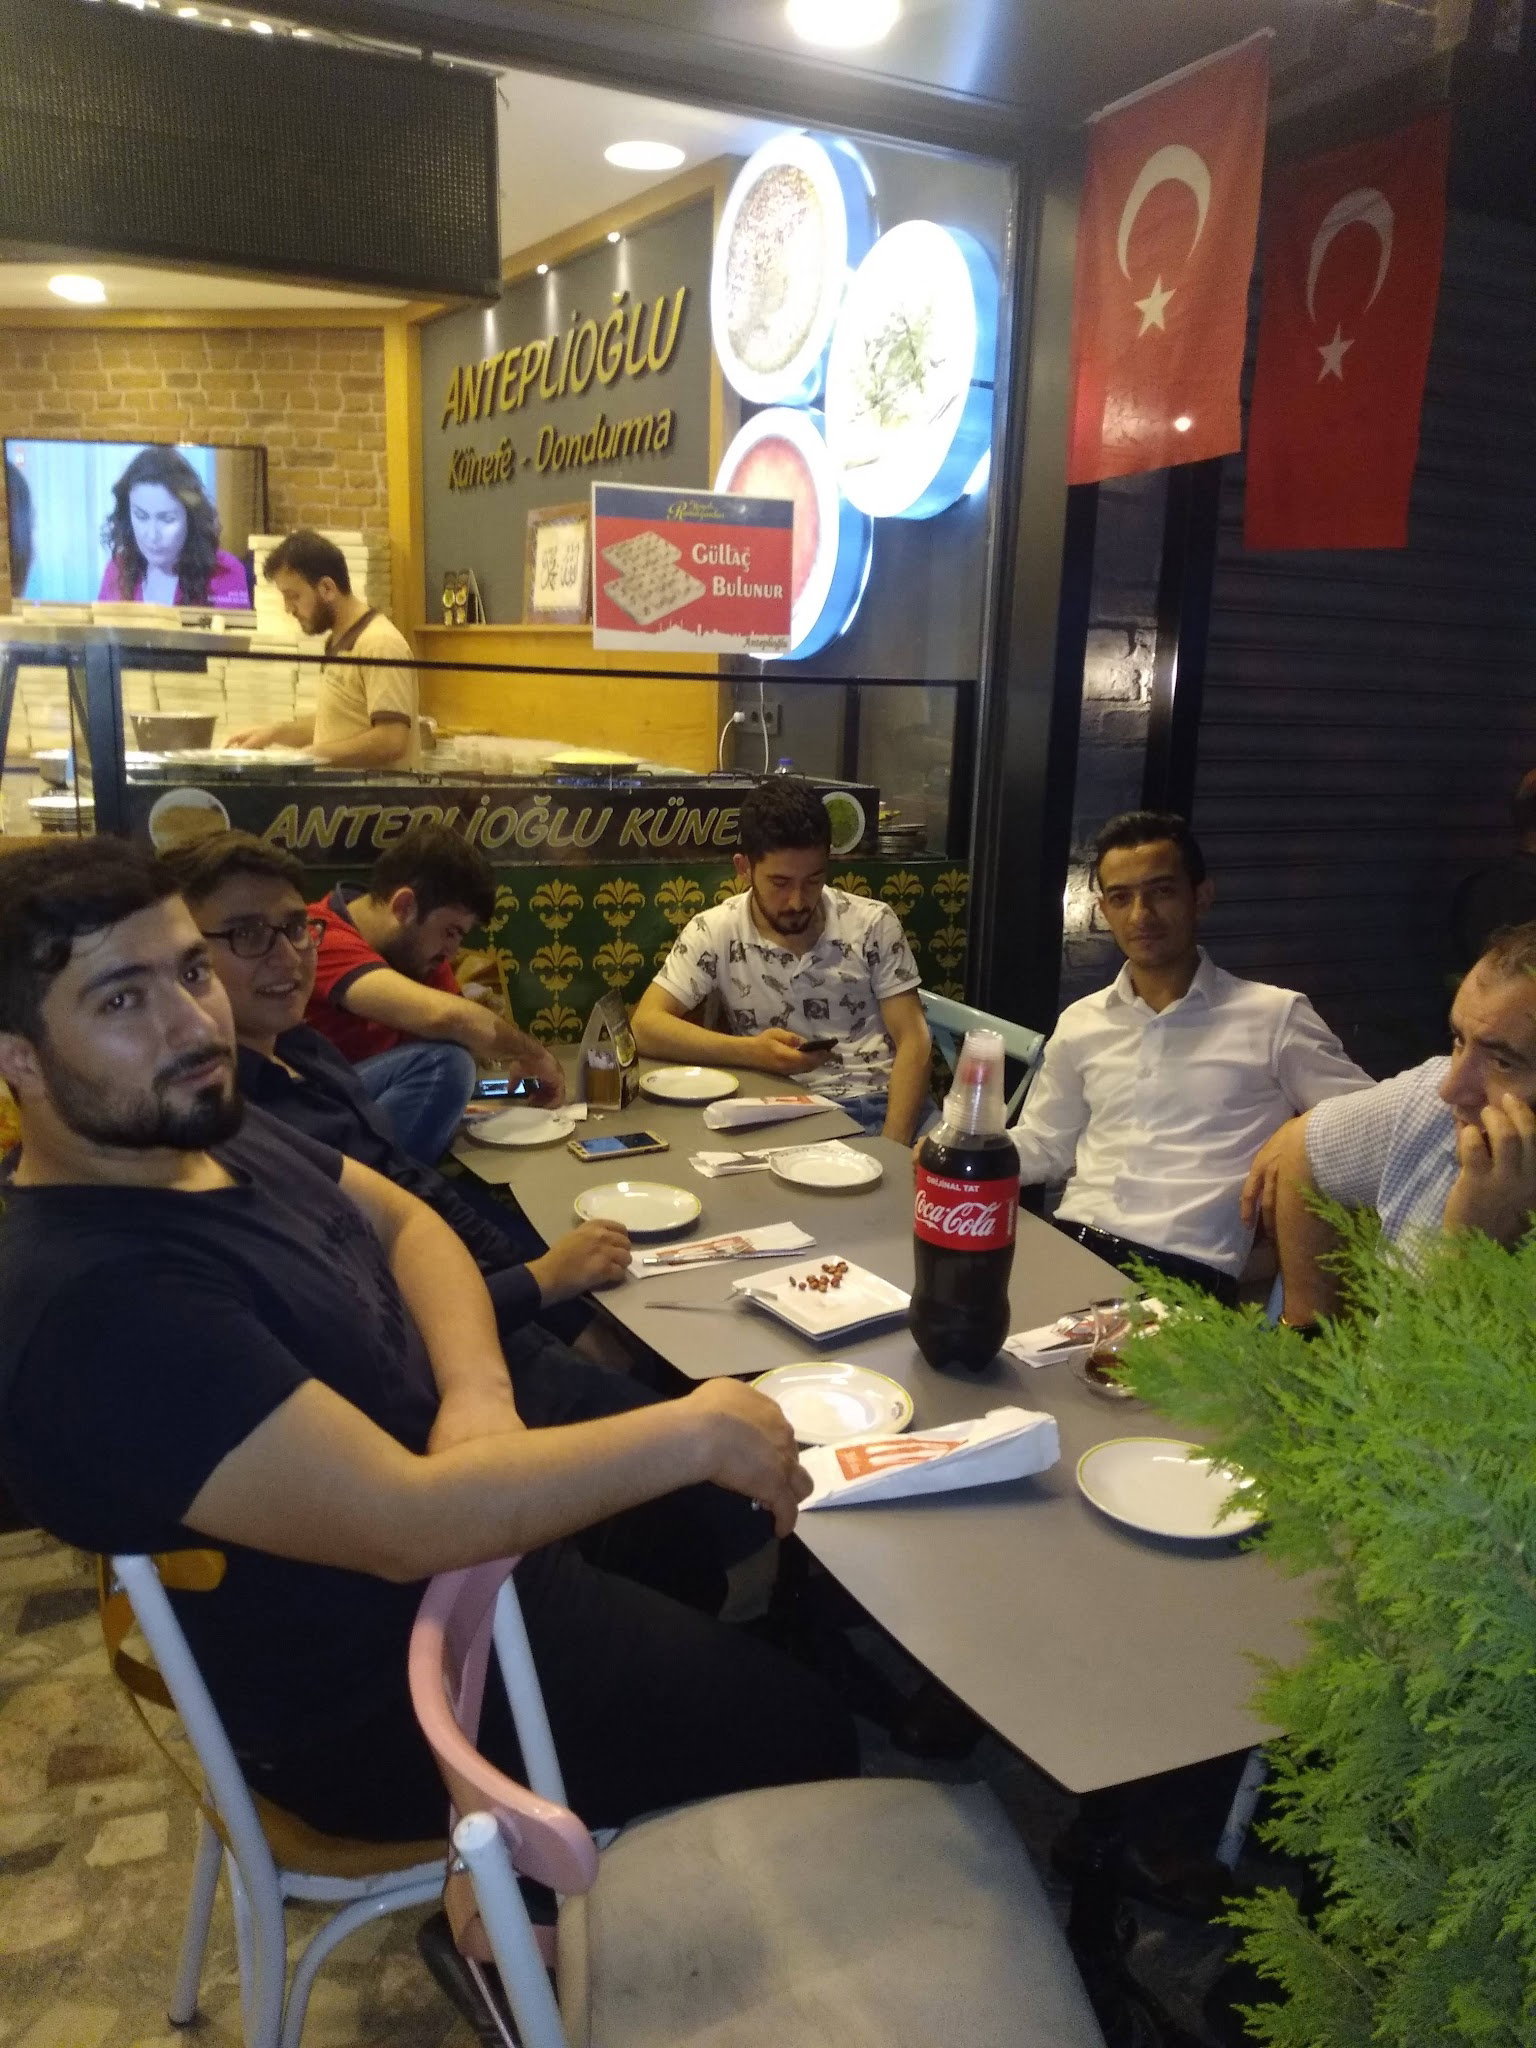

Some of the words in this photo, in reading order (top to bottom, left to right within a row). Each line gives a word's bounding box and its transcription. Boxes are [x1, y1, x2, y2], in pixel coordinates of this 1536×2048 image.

[442, 287, 686, 430] ANTEPLİOĞLU
[535, 408, 672, 474] Dondurma
[619, 796, 742, 848] KÜNE
[914, 1190, 1002, 1238] Coca-Cola
[963, 1184, 980, 1193] TAT
